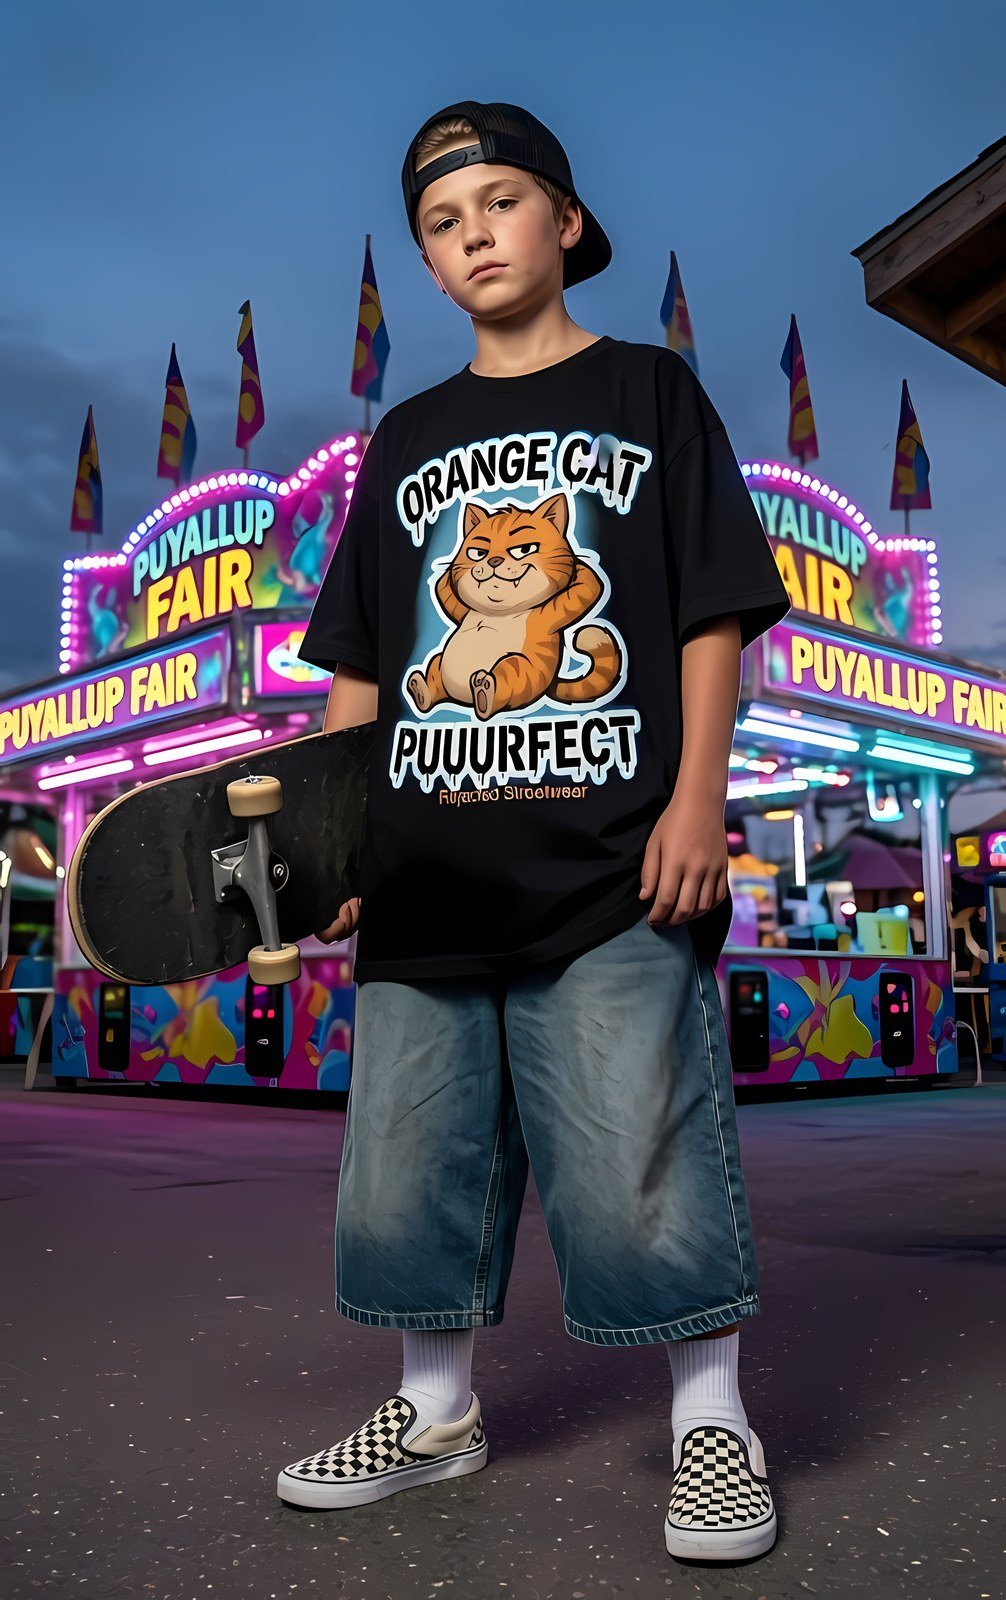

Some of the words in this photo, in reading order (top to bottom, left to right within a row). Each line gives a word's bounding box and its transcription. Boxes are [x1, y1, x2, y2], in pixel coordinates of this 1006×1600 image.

[402, 438, 551, 539] ORANGE
[133, 499, 275, 597] PUYALLUP
[751, 490, 866, 577] YALLUP
[146, 548, 252, 641] FAIR
[774, 544, 854, 626] AIR
[130, 652, 198, 716] FAIR
[791, 635, 946, 717] PUYALLUP
[393, 715, 636, 786] PUUURFECT
